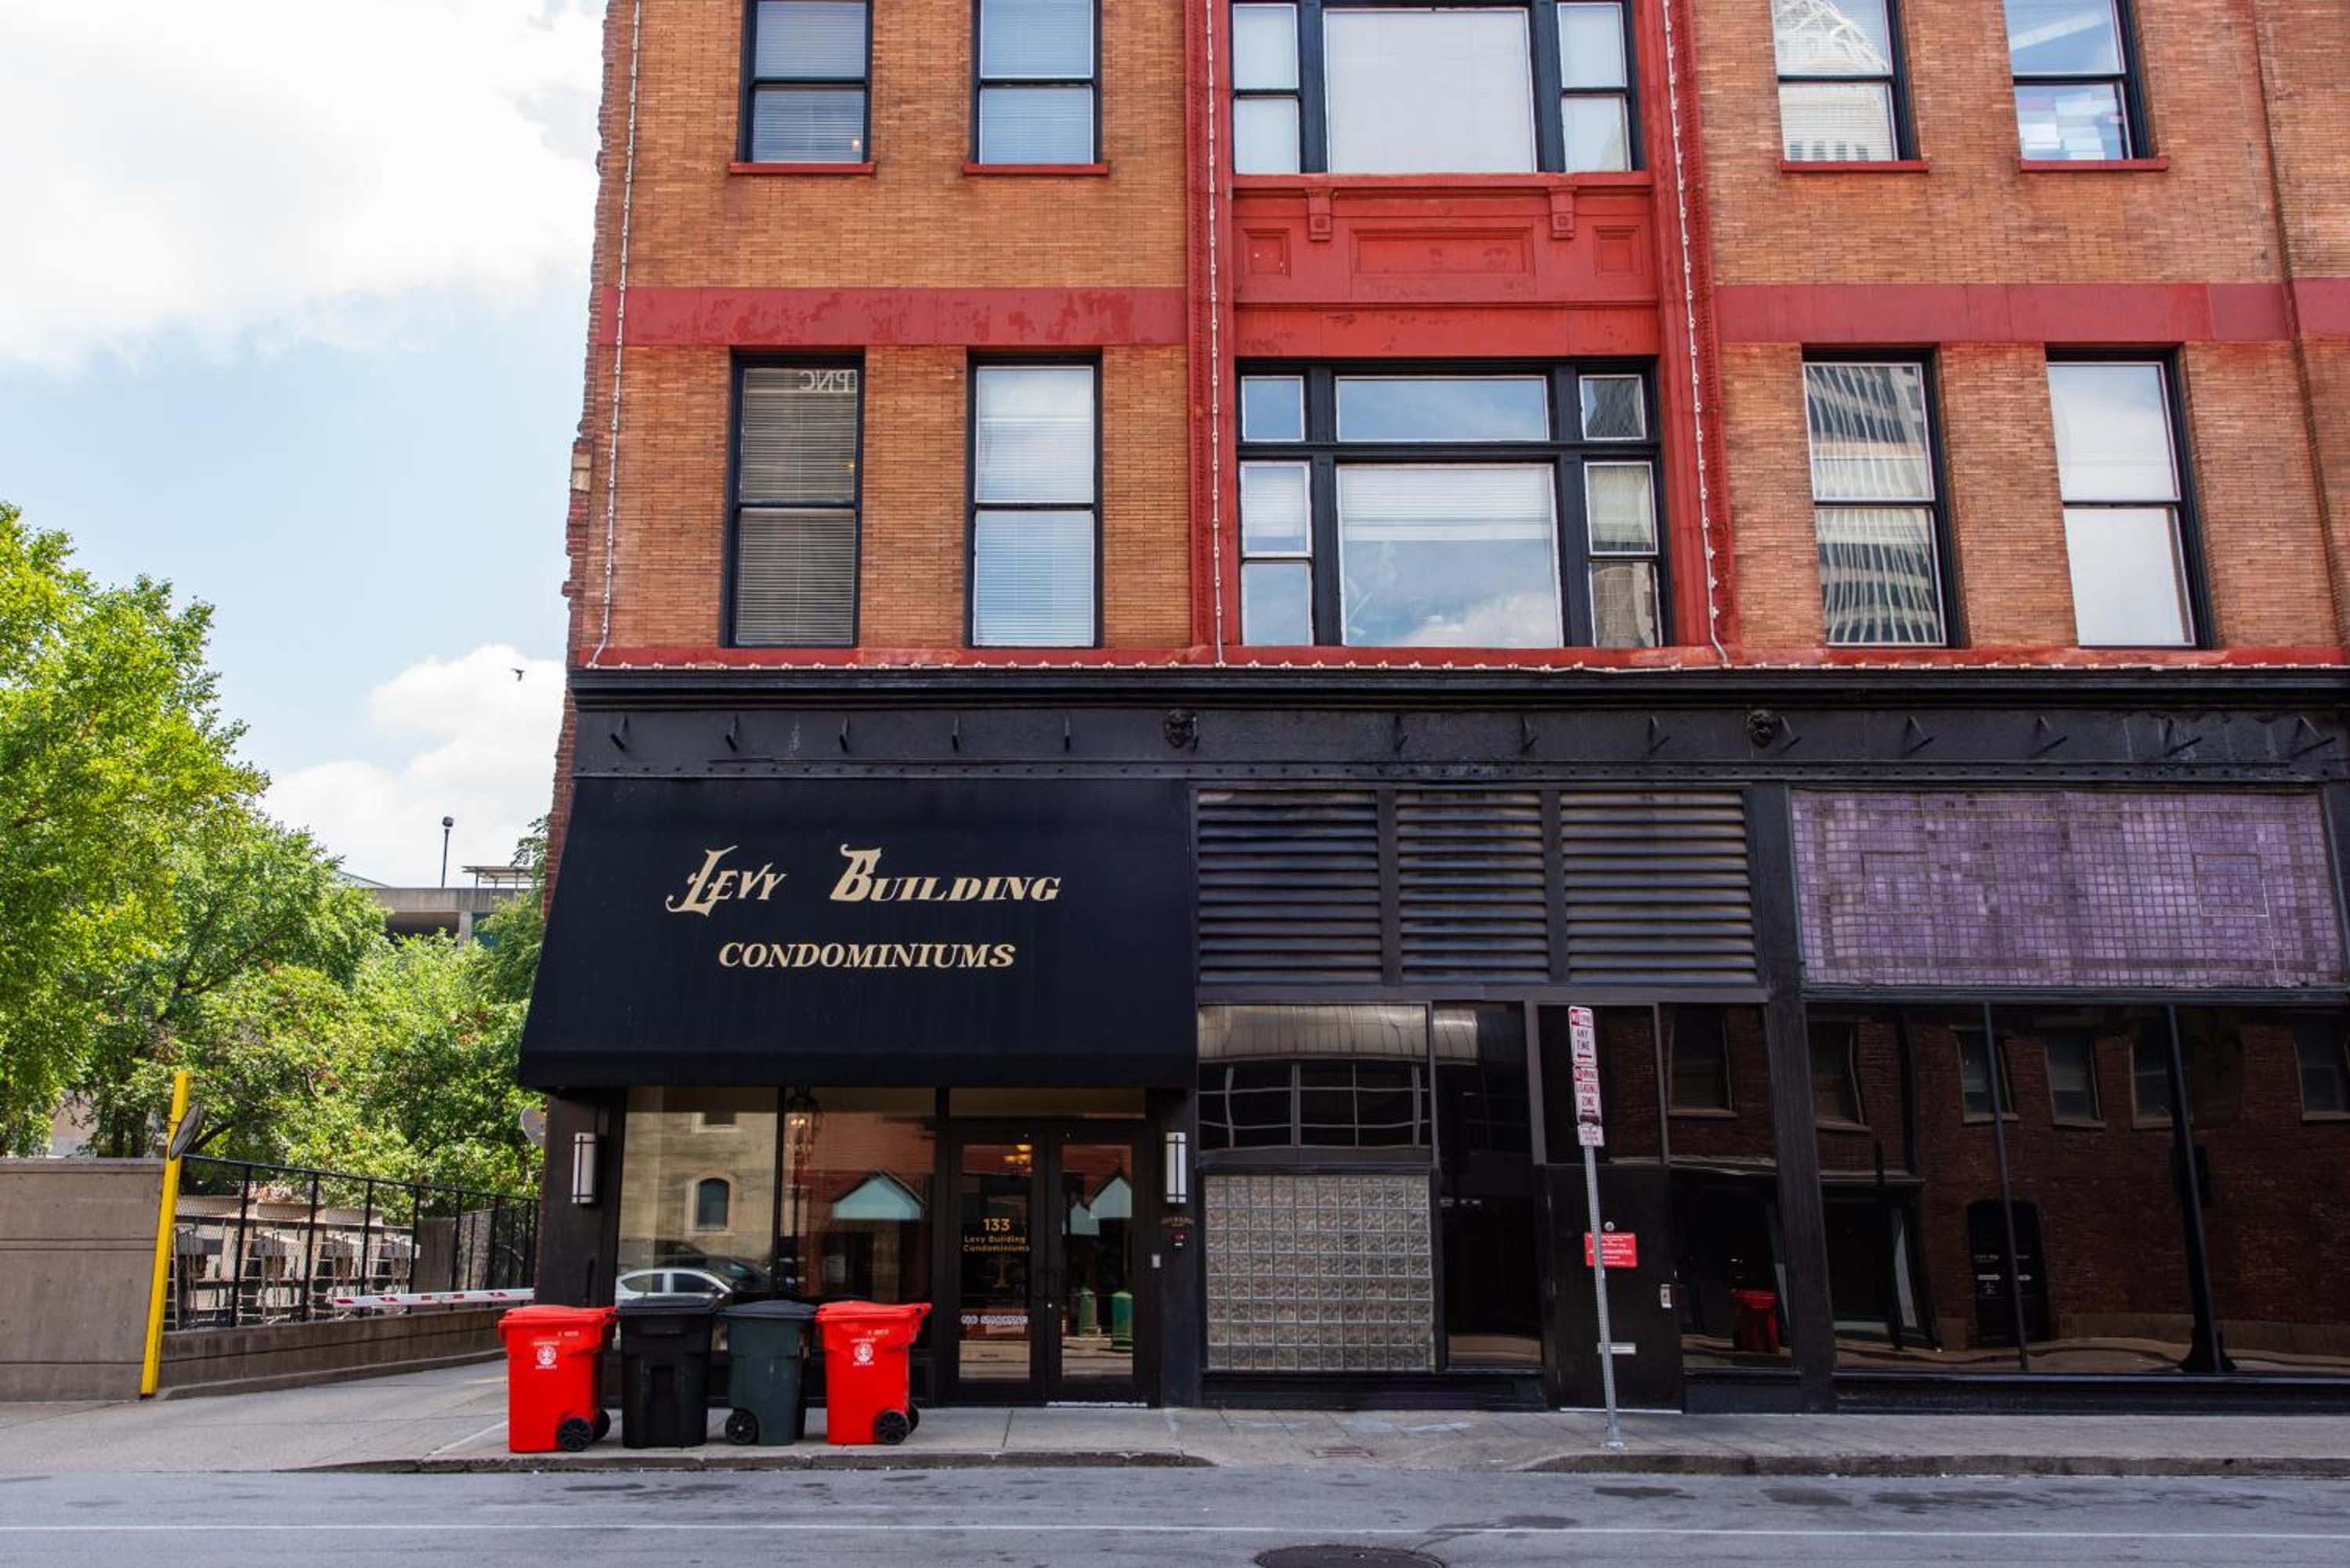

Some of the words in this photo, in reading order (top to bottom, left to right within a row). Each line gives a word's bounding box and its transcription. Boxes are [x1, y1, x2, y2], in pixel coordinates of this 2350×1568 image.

[718, 942, 1017, 969] CONDOMINIUMS
[1577, 1028, 1589, 1039] ANY
[1577, 1040, 1590, 1050] TIME
[983, 1218, 1010, 1232] 133
[988, 1234, 1026, 1245] Building
[963, 1244, 1031, 1252] Condominiums
